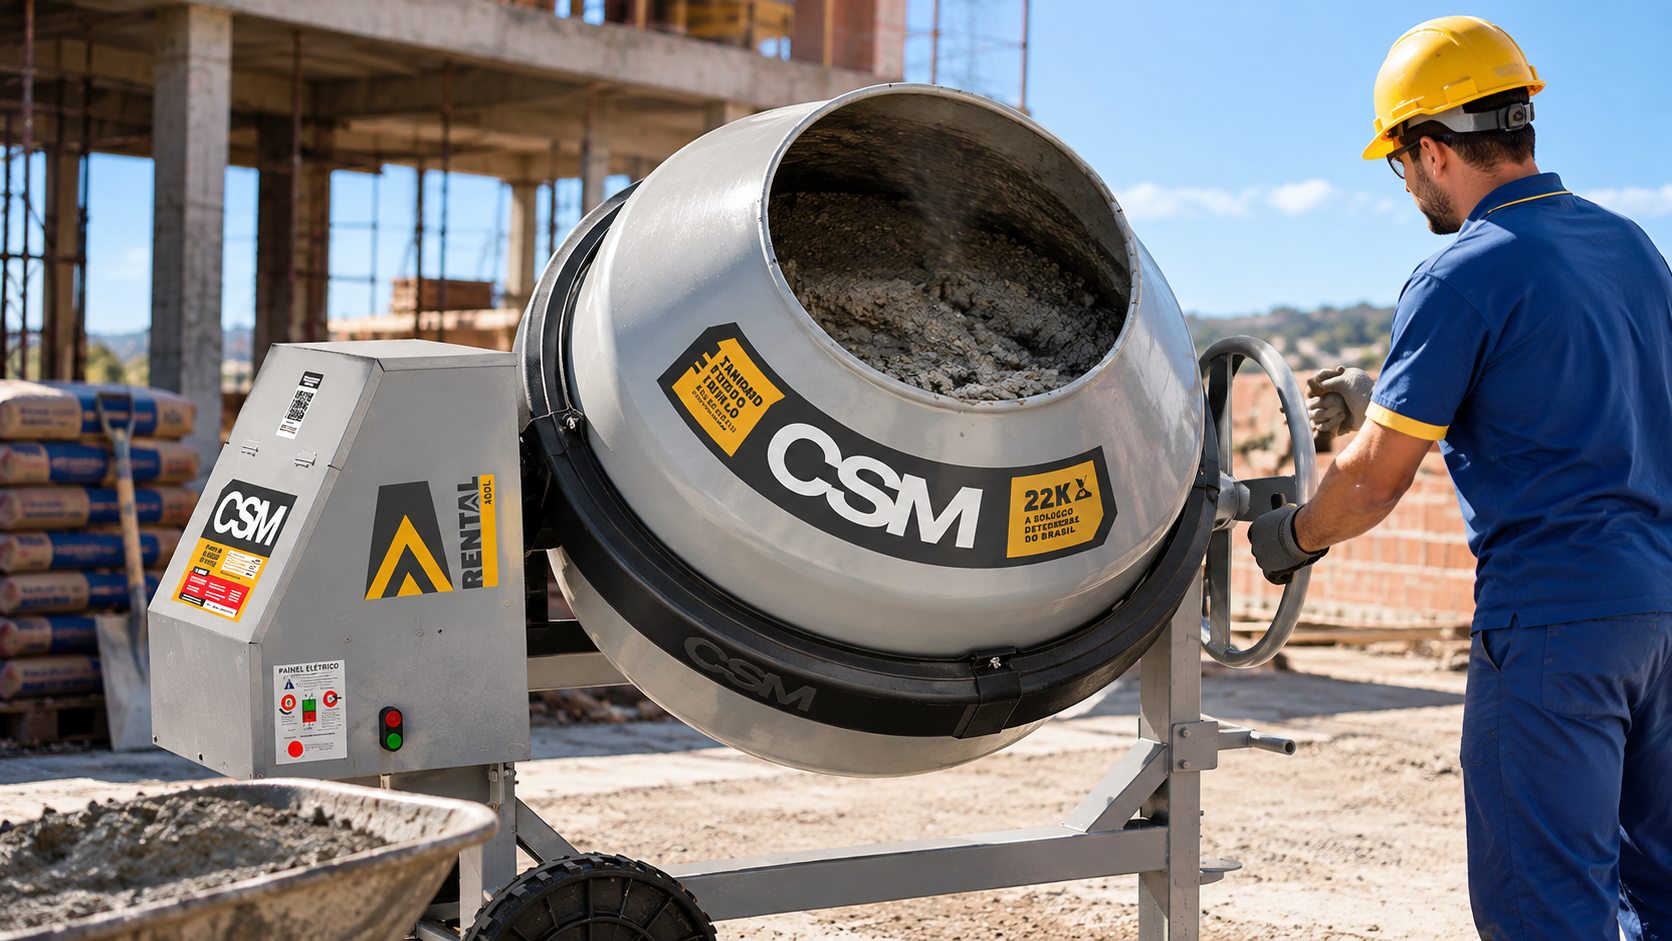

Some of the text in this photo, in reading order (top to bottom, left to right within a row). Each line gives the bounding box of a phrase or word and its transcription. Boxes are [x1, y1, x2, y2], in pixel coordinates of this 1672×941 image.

[767, 422, 984, 549] CSM
[1023, 482, 1072, 513] 22K
[213, 490, 288, 547] CSM
[457, 476, 484, 590] RENTAL
[1025, 525, 1076, 543] DO BRASIL
[278, 662, 340, 674] PAINEL ELÉTRICO
[683, 636, 818, 712] CSM
